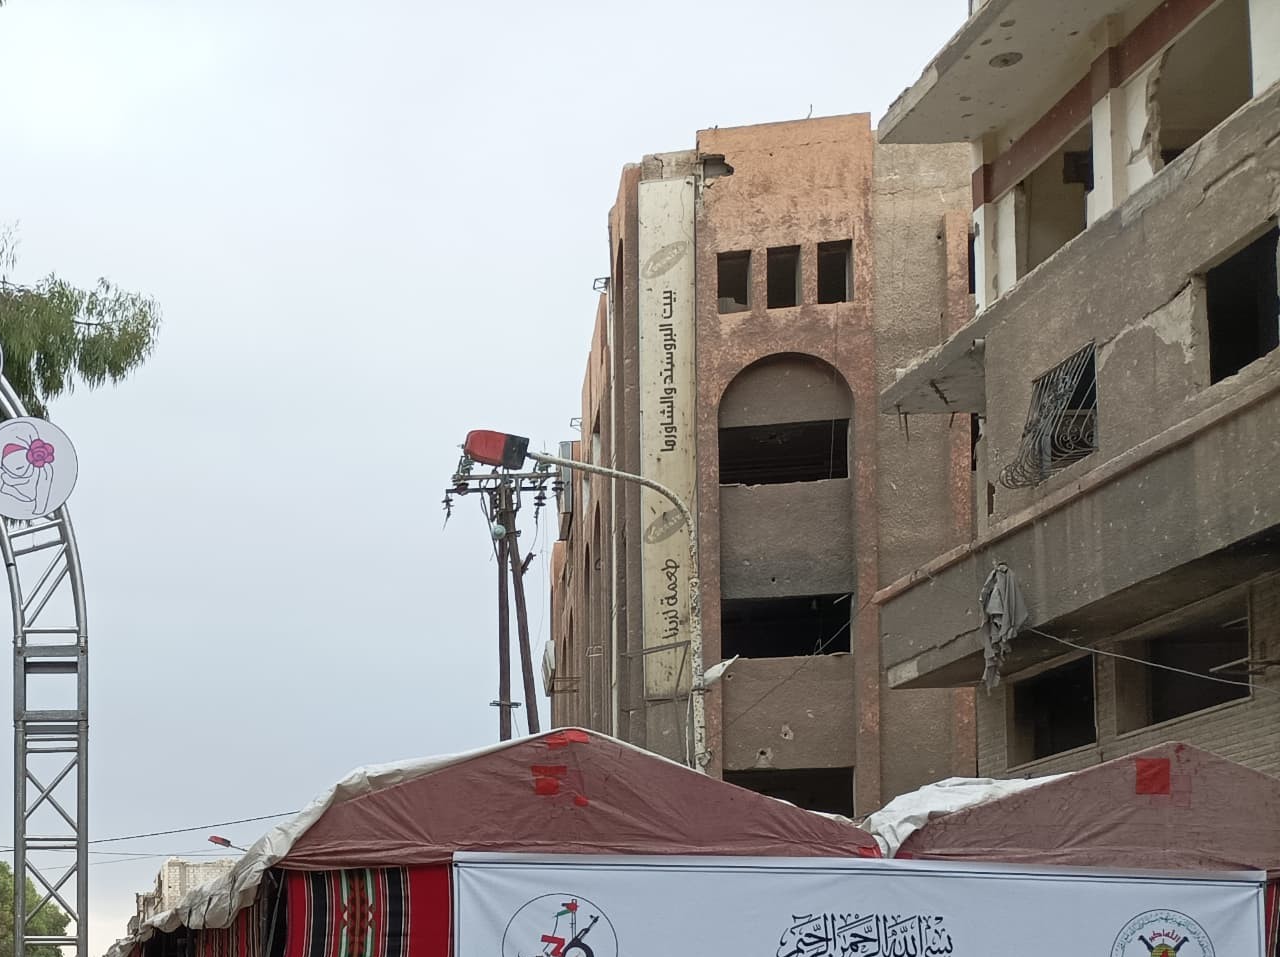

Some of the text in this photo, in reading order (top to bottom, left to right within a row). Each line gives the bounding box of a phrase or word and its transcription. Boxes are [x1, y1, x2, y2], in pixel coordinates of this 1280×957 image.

[658, 290, 677, 452] بيت البروستد والشاورما
[660, 558, 680, 607] طعمة
